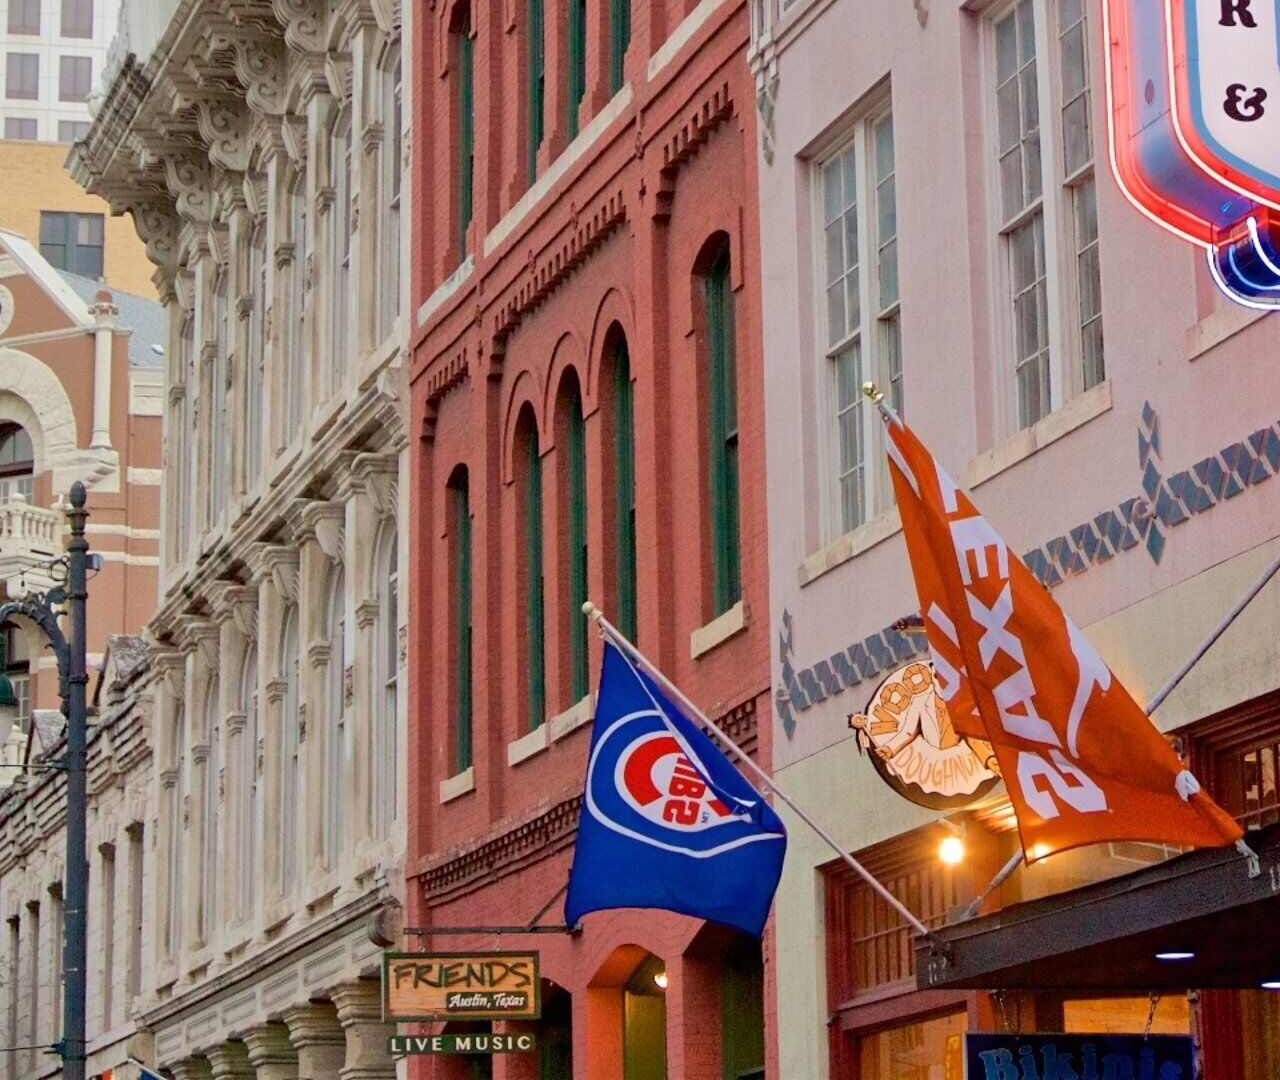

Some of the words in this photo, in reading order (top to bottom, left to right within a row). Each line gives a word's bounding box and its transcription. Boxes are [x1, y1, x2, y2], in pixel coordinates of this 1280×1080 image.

[1222, 83, 1268, 123] &
[393, 961, 531, 989] FRIENDS
[448, 991, 492, 1008] Austin,
[493, 992, 525, 1007] Texas
[390, 1037, 443, 1052] LIVE
[455, 1035, 531, 1050] MUSIC
